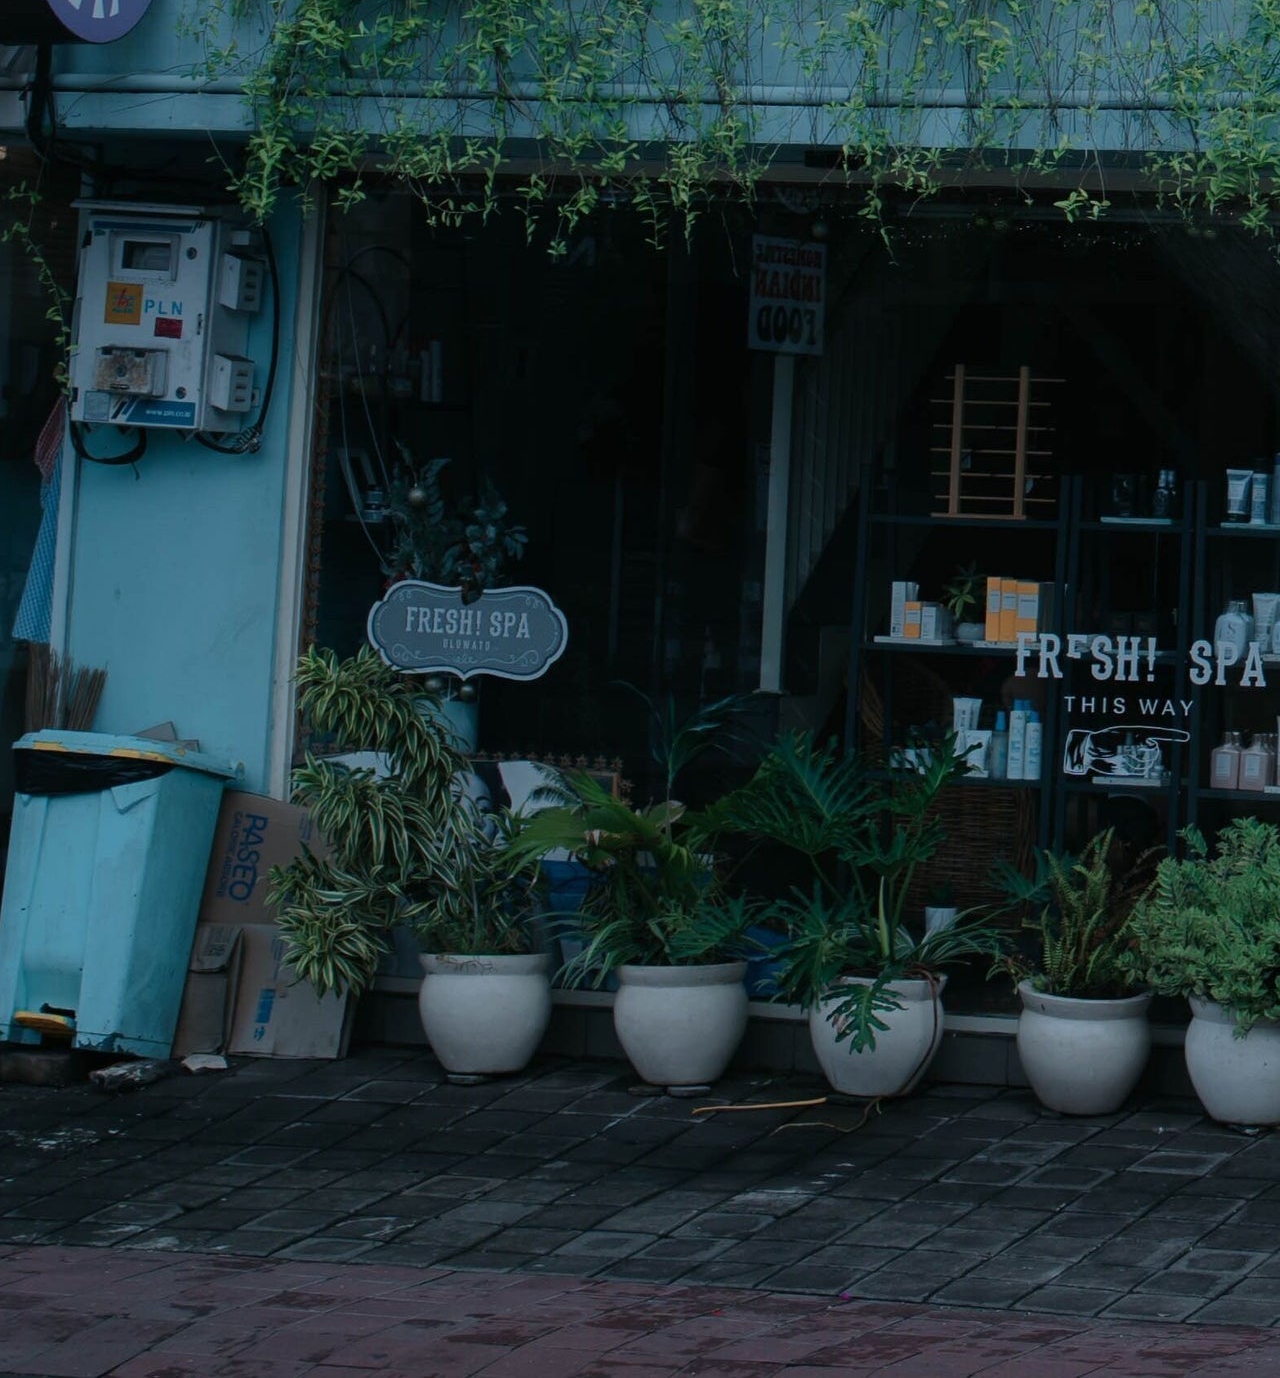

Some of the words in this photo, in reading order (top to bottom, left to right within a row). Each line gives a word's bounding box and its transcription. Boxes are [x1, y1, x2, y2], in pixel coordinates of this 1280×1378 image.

[144, 299, 184, 316] PLN
[405, 606, 482, 636] FRESH!
[489, 611, 531, 639] SPA
[1189, 640, 1267, 687] SPA
[1063, 696, 1127, 714] THIS
[1139, 698, 1195, 717] WAY
